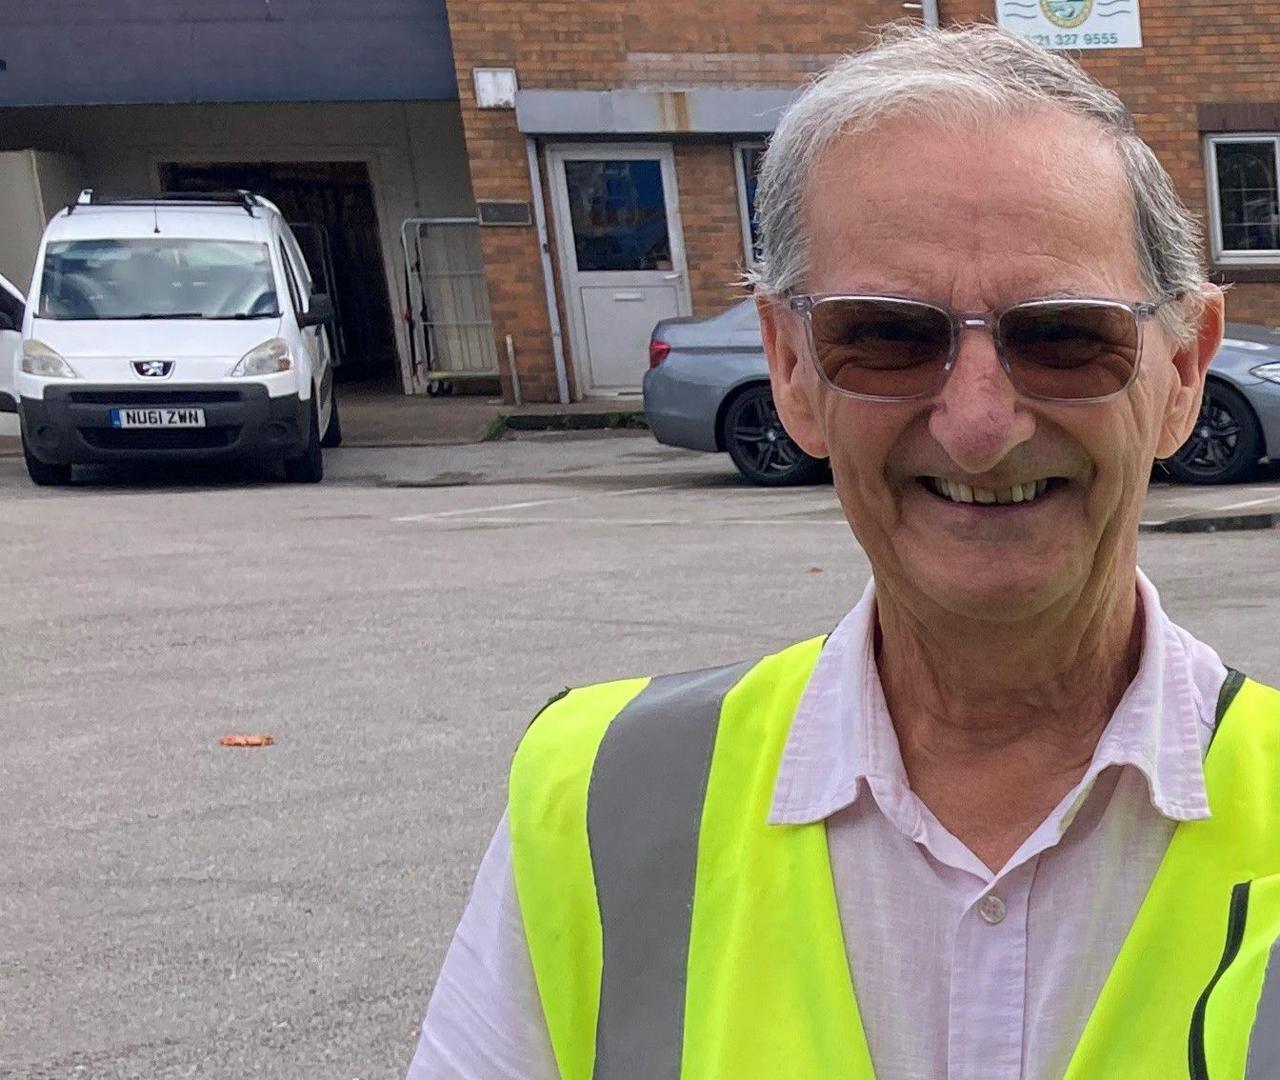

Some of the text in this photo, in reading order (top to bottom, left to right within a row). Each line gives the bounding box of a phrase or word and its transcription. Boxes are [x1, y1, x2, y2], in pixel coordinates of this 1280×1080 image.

[1055, 34, 1079, 46] 327
[1083, 33, 1118, 45] 9555
[126, 410, 200, 425] NU61 ZWN
